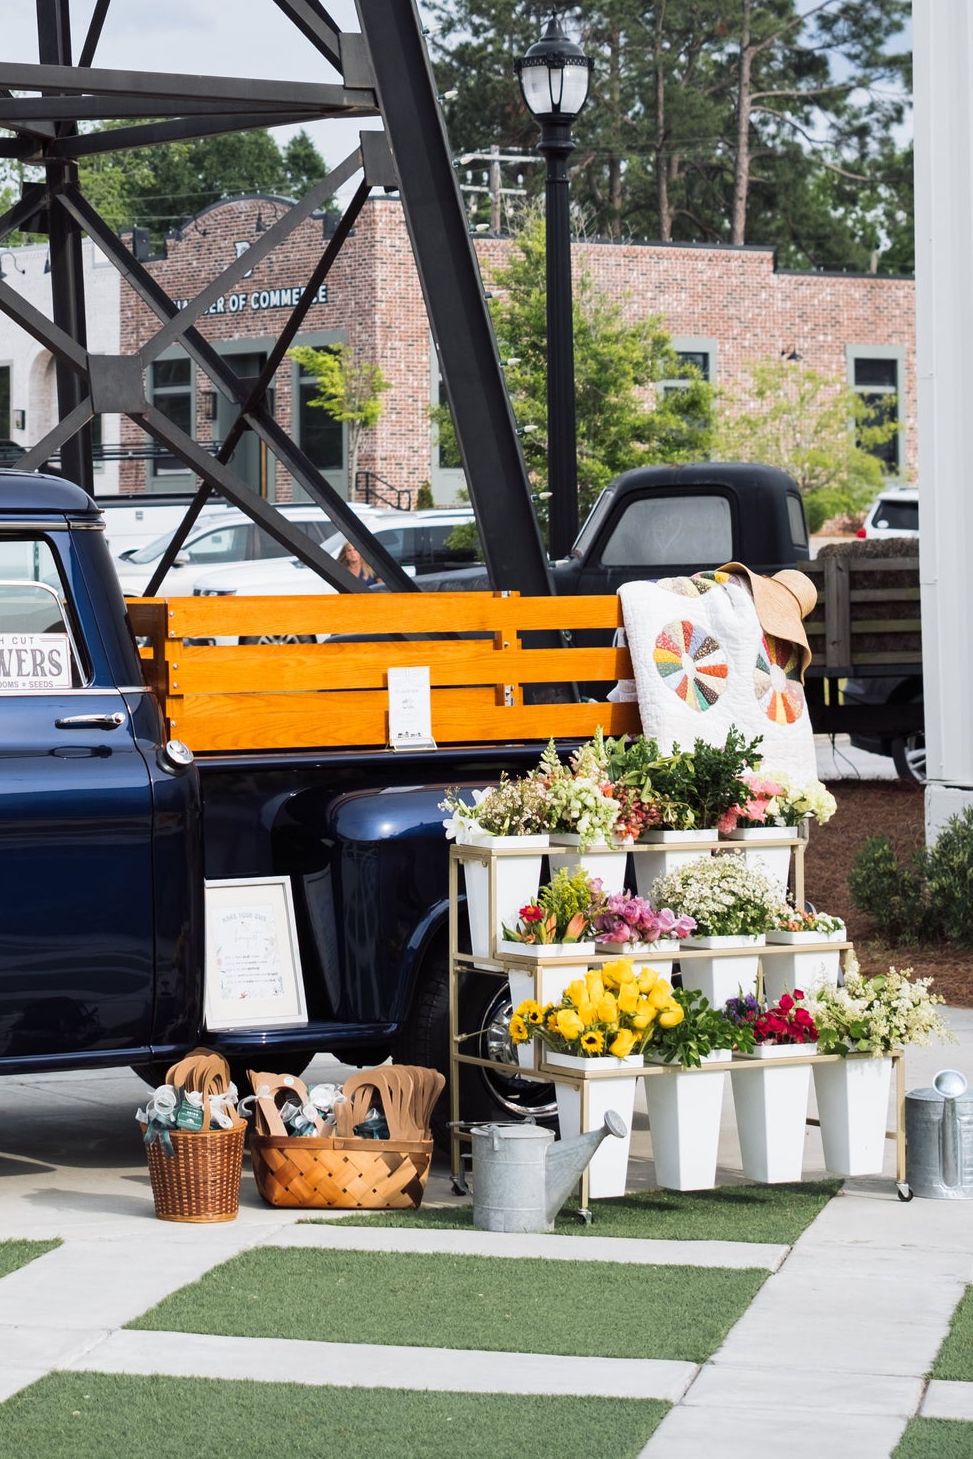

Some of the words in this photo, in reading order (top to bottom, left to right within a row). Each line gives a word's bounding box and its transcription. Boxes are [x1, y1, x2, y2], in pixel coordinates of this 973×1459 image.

[229, 293, 247, 312] OF
[251, 284, 327, 310] COMMEE
[12, 636, 35, 645] CUT
[29, 680, 54, 688] SEEDS
